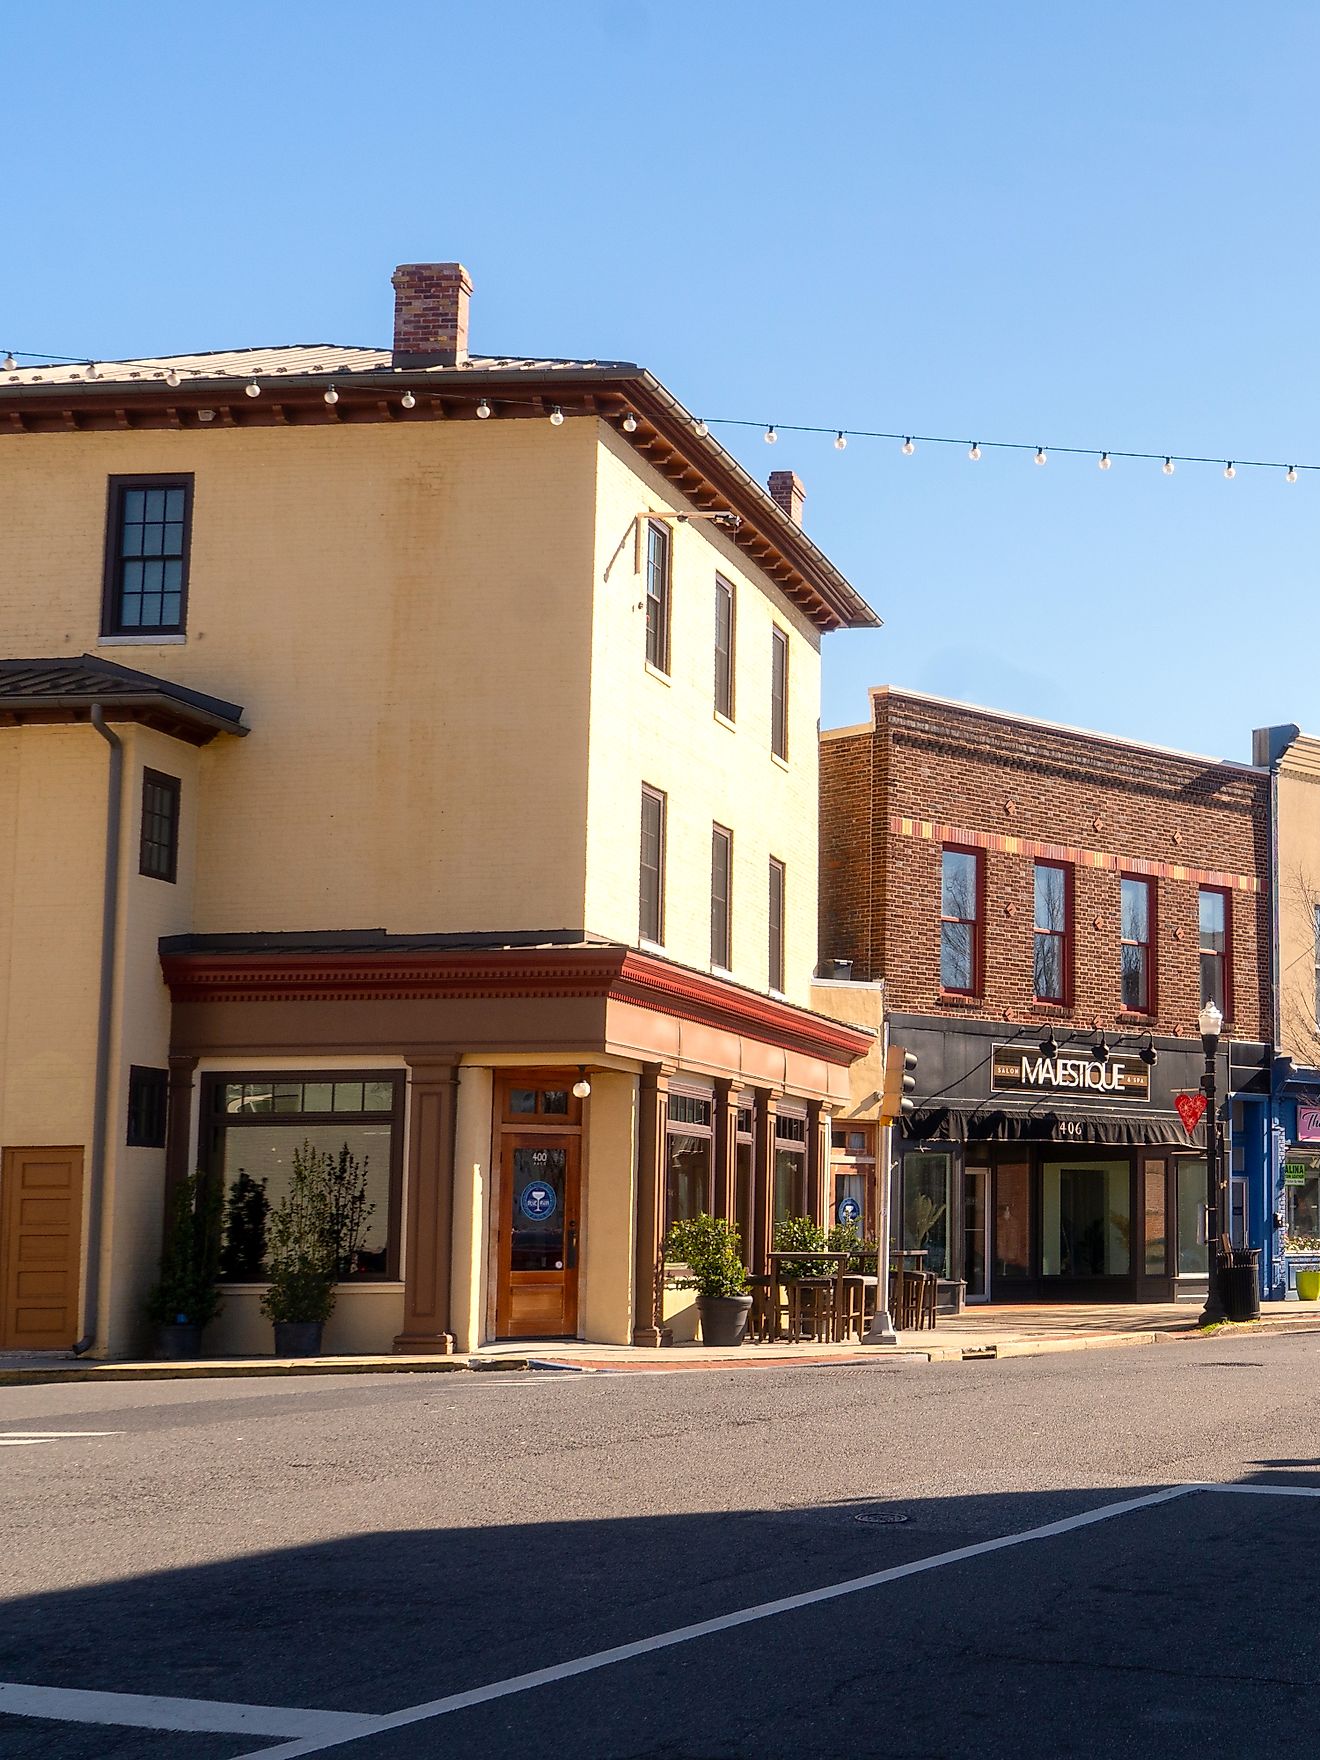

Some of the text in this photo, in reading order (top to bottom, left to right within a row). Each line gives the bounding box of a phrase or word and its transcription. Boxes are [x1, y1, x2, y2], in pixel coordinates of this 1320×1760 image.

[997, 1066, 1019, 1075] SALON
[1021, 1056, 1126, 1093] MAJESTIQUE
[1059, 1121, 1082, 1135] 406
[532, 1152, 548, 1162] 400
